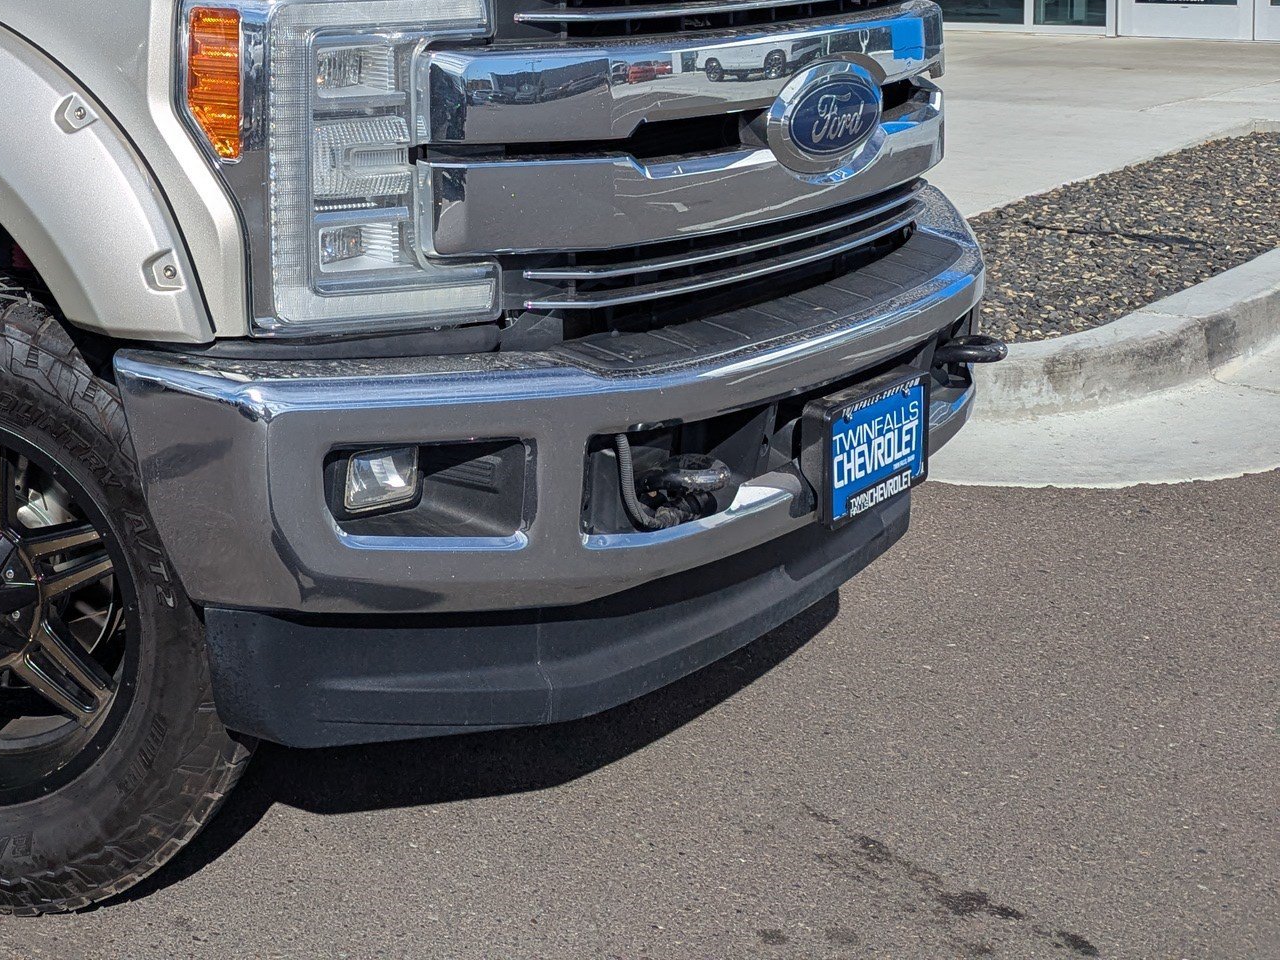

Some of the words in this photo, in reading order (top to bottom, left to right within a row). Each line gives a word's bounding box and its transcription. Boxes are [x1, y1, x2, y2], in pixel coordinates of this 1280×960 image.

[811, 91, 865, 144] Ford
[832, 400, 919, 455] TWINFALLS
[833, 418, 918, 490] CHEVROLET
[849, 500, 869, 518] FALLS
[850, 492, 869, 509] TWIN
[868, 469, 912, 508] CHEVROLET
